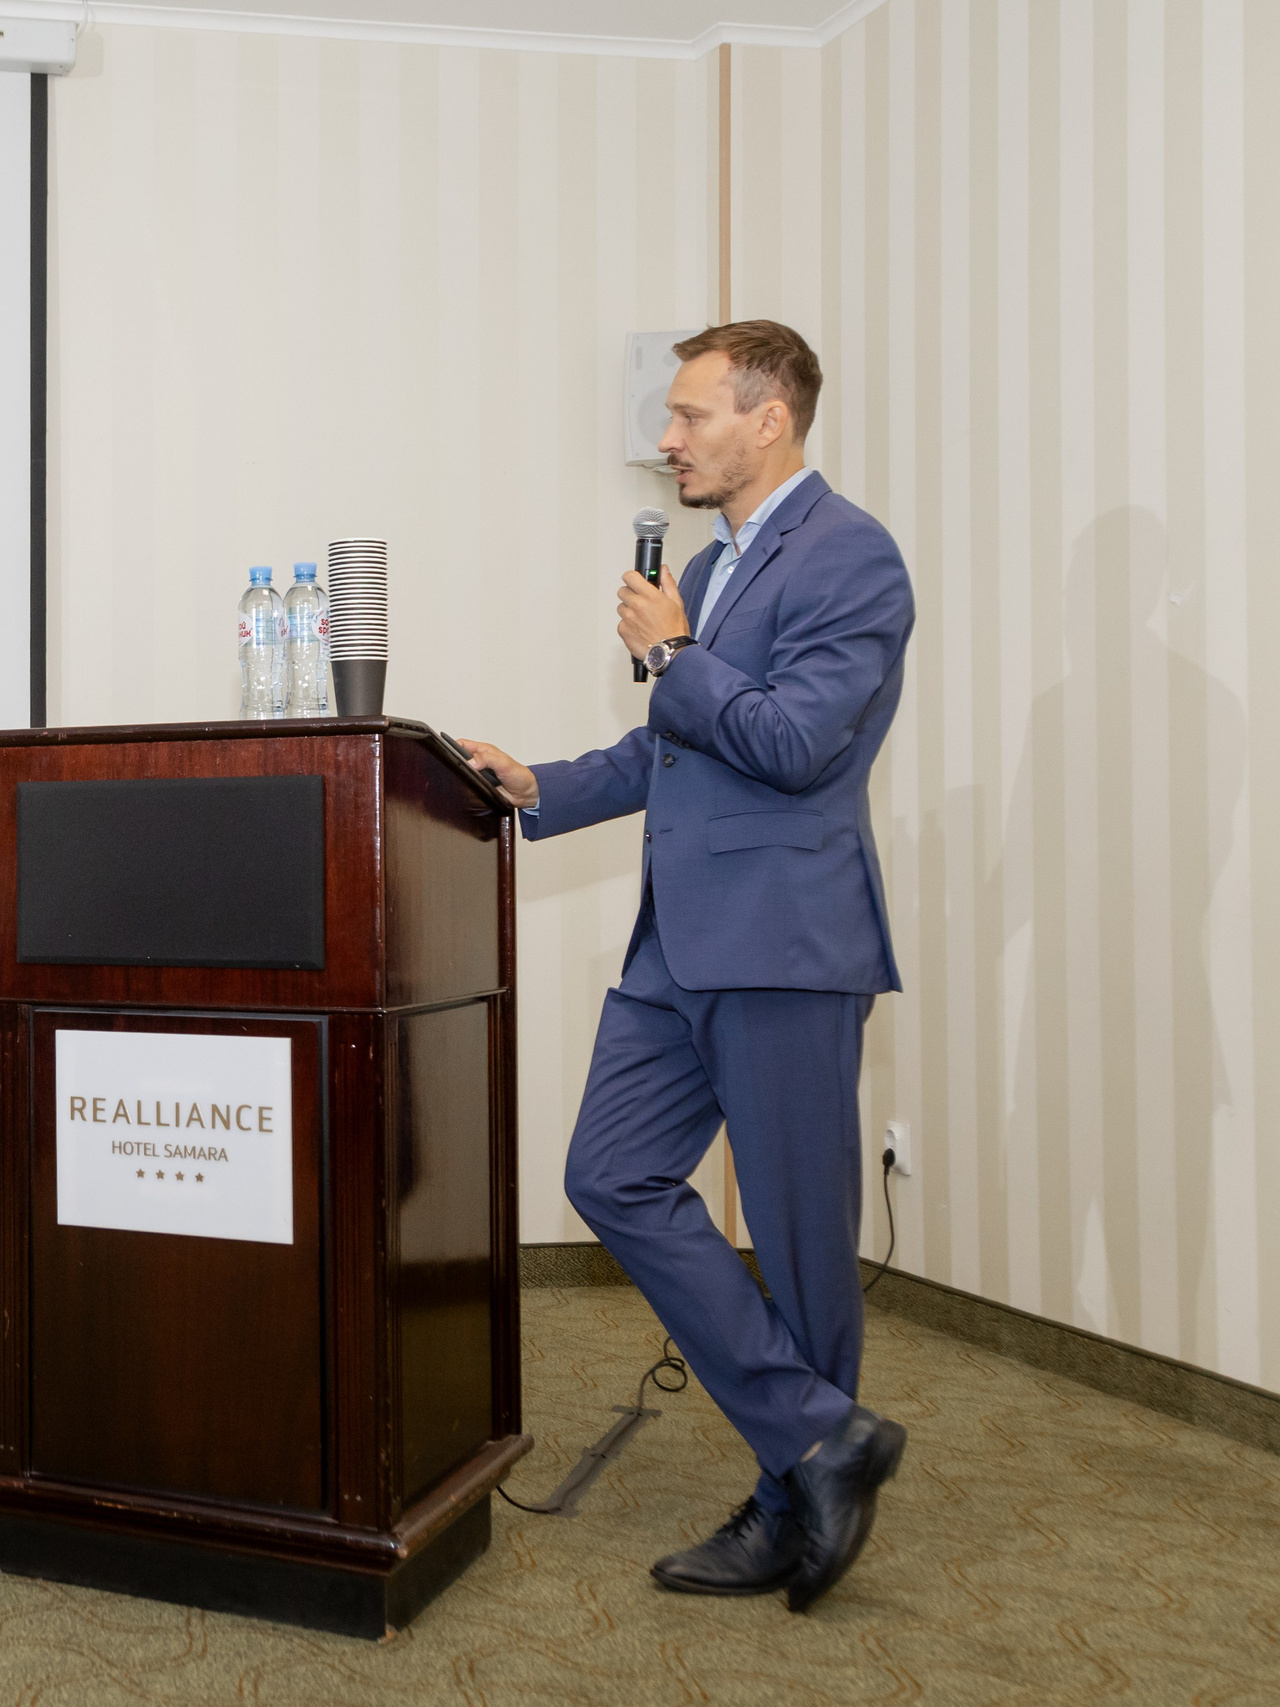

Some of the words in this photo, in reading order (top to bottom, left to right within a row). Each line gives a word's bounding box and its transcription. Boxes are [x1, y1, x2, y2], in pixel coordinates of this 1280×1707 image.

[69, 1095, 274, 1133] REALLIANCE
[111, 1140, 161, 1158] HOTEL
[163, 1143, 229, 1162] SAMARA
